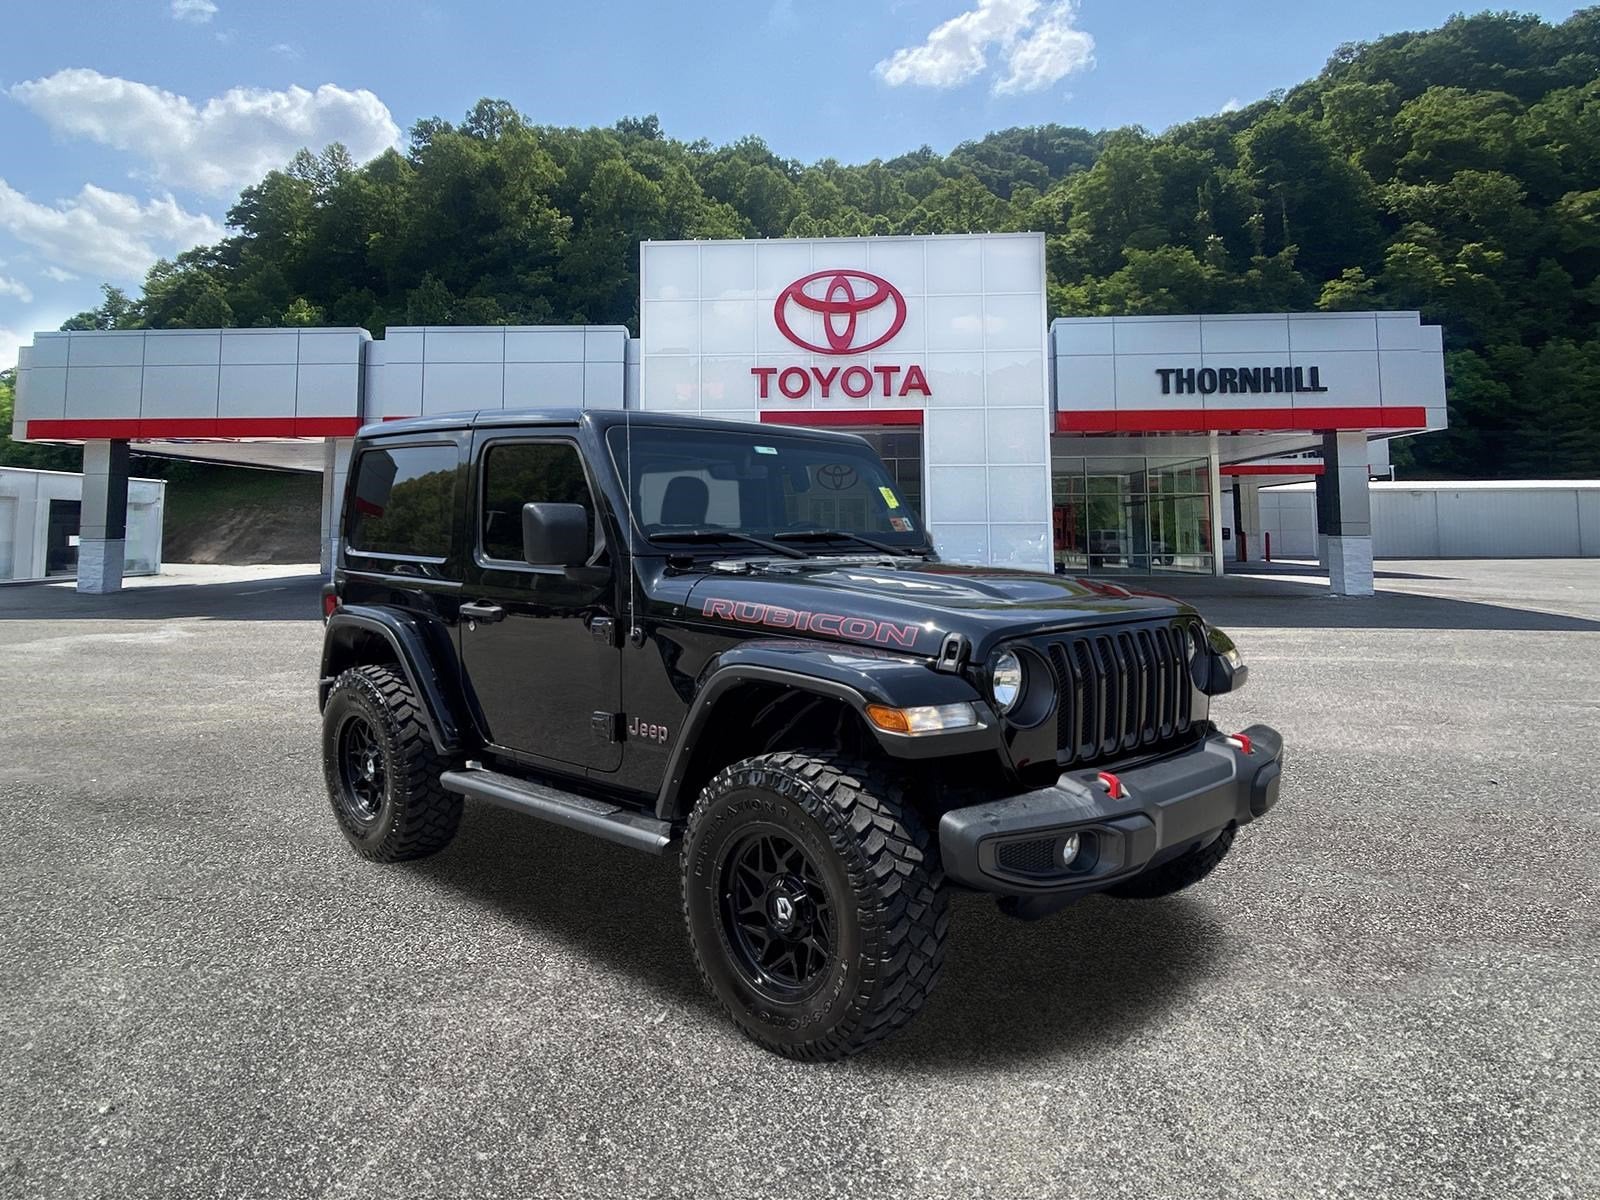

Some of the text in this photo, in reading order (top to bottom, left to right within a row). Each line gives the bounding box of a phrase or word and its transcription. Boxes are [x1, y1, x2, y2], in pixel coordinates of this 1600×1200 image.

[751, 365, 932, 398] TOYOTA
[1155, 366, 1328, 394] THORNHILL
[702, 598, 919, 647] RUBICON
[629, 717, 668, 744] Jeep
